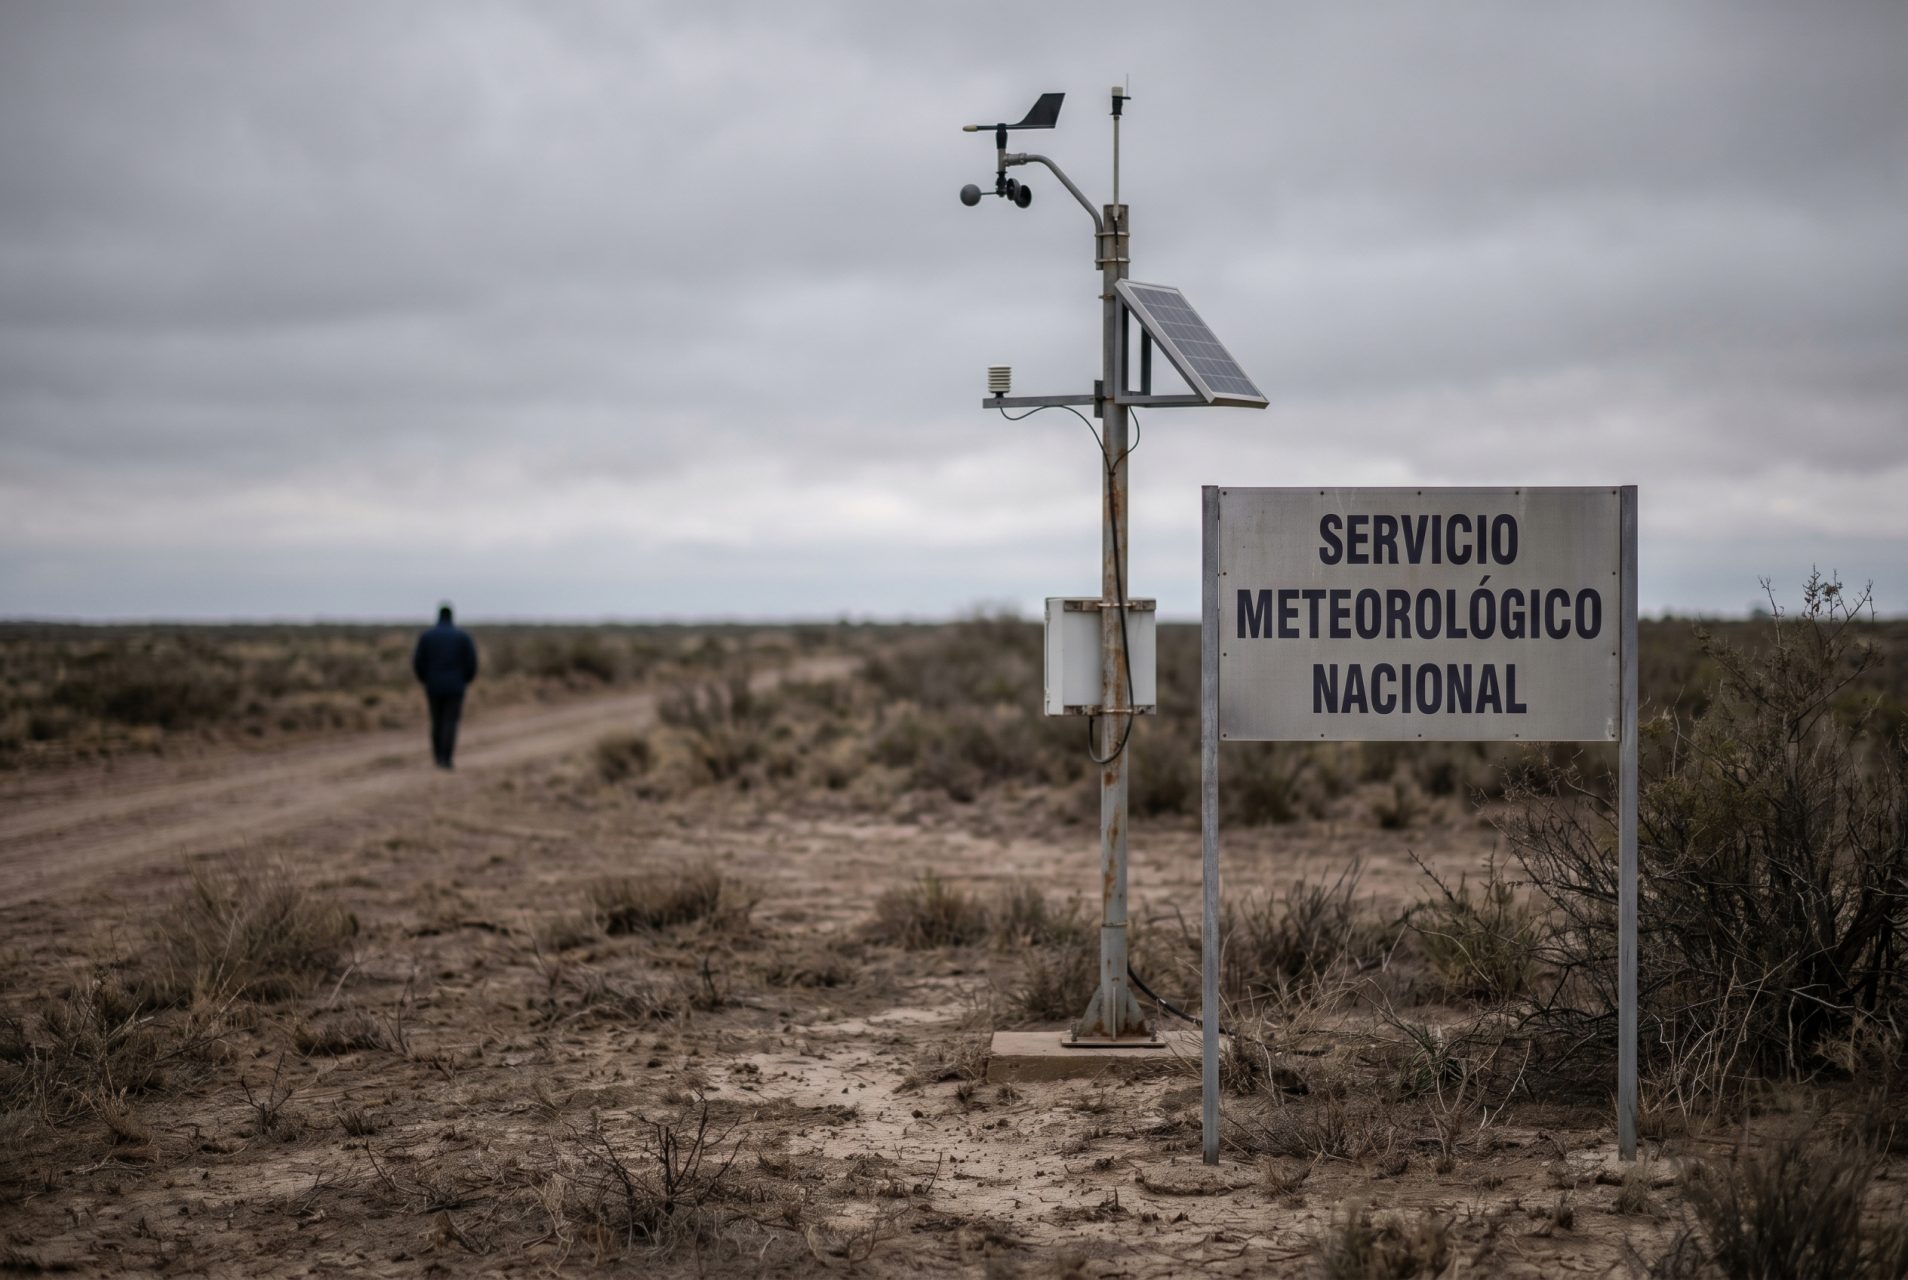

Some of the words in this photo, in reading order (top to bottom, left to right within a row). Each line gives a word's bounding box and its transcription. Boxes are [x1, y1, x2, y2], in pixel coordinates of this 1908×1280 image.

[1319, 513, 1519, 566] SERVICIO
[1236, 575, 1603, 640] METEOROLÓGICO
[1312, 662, 1528, 715] NACIONAL
